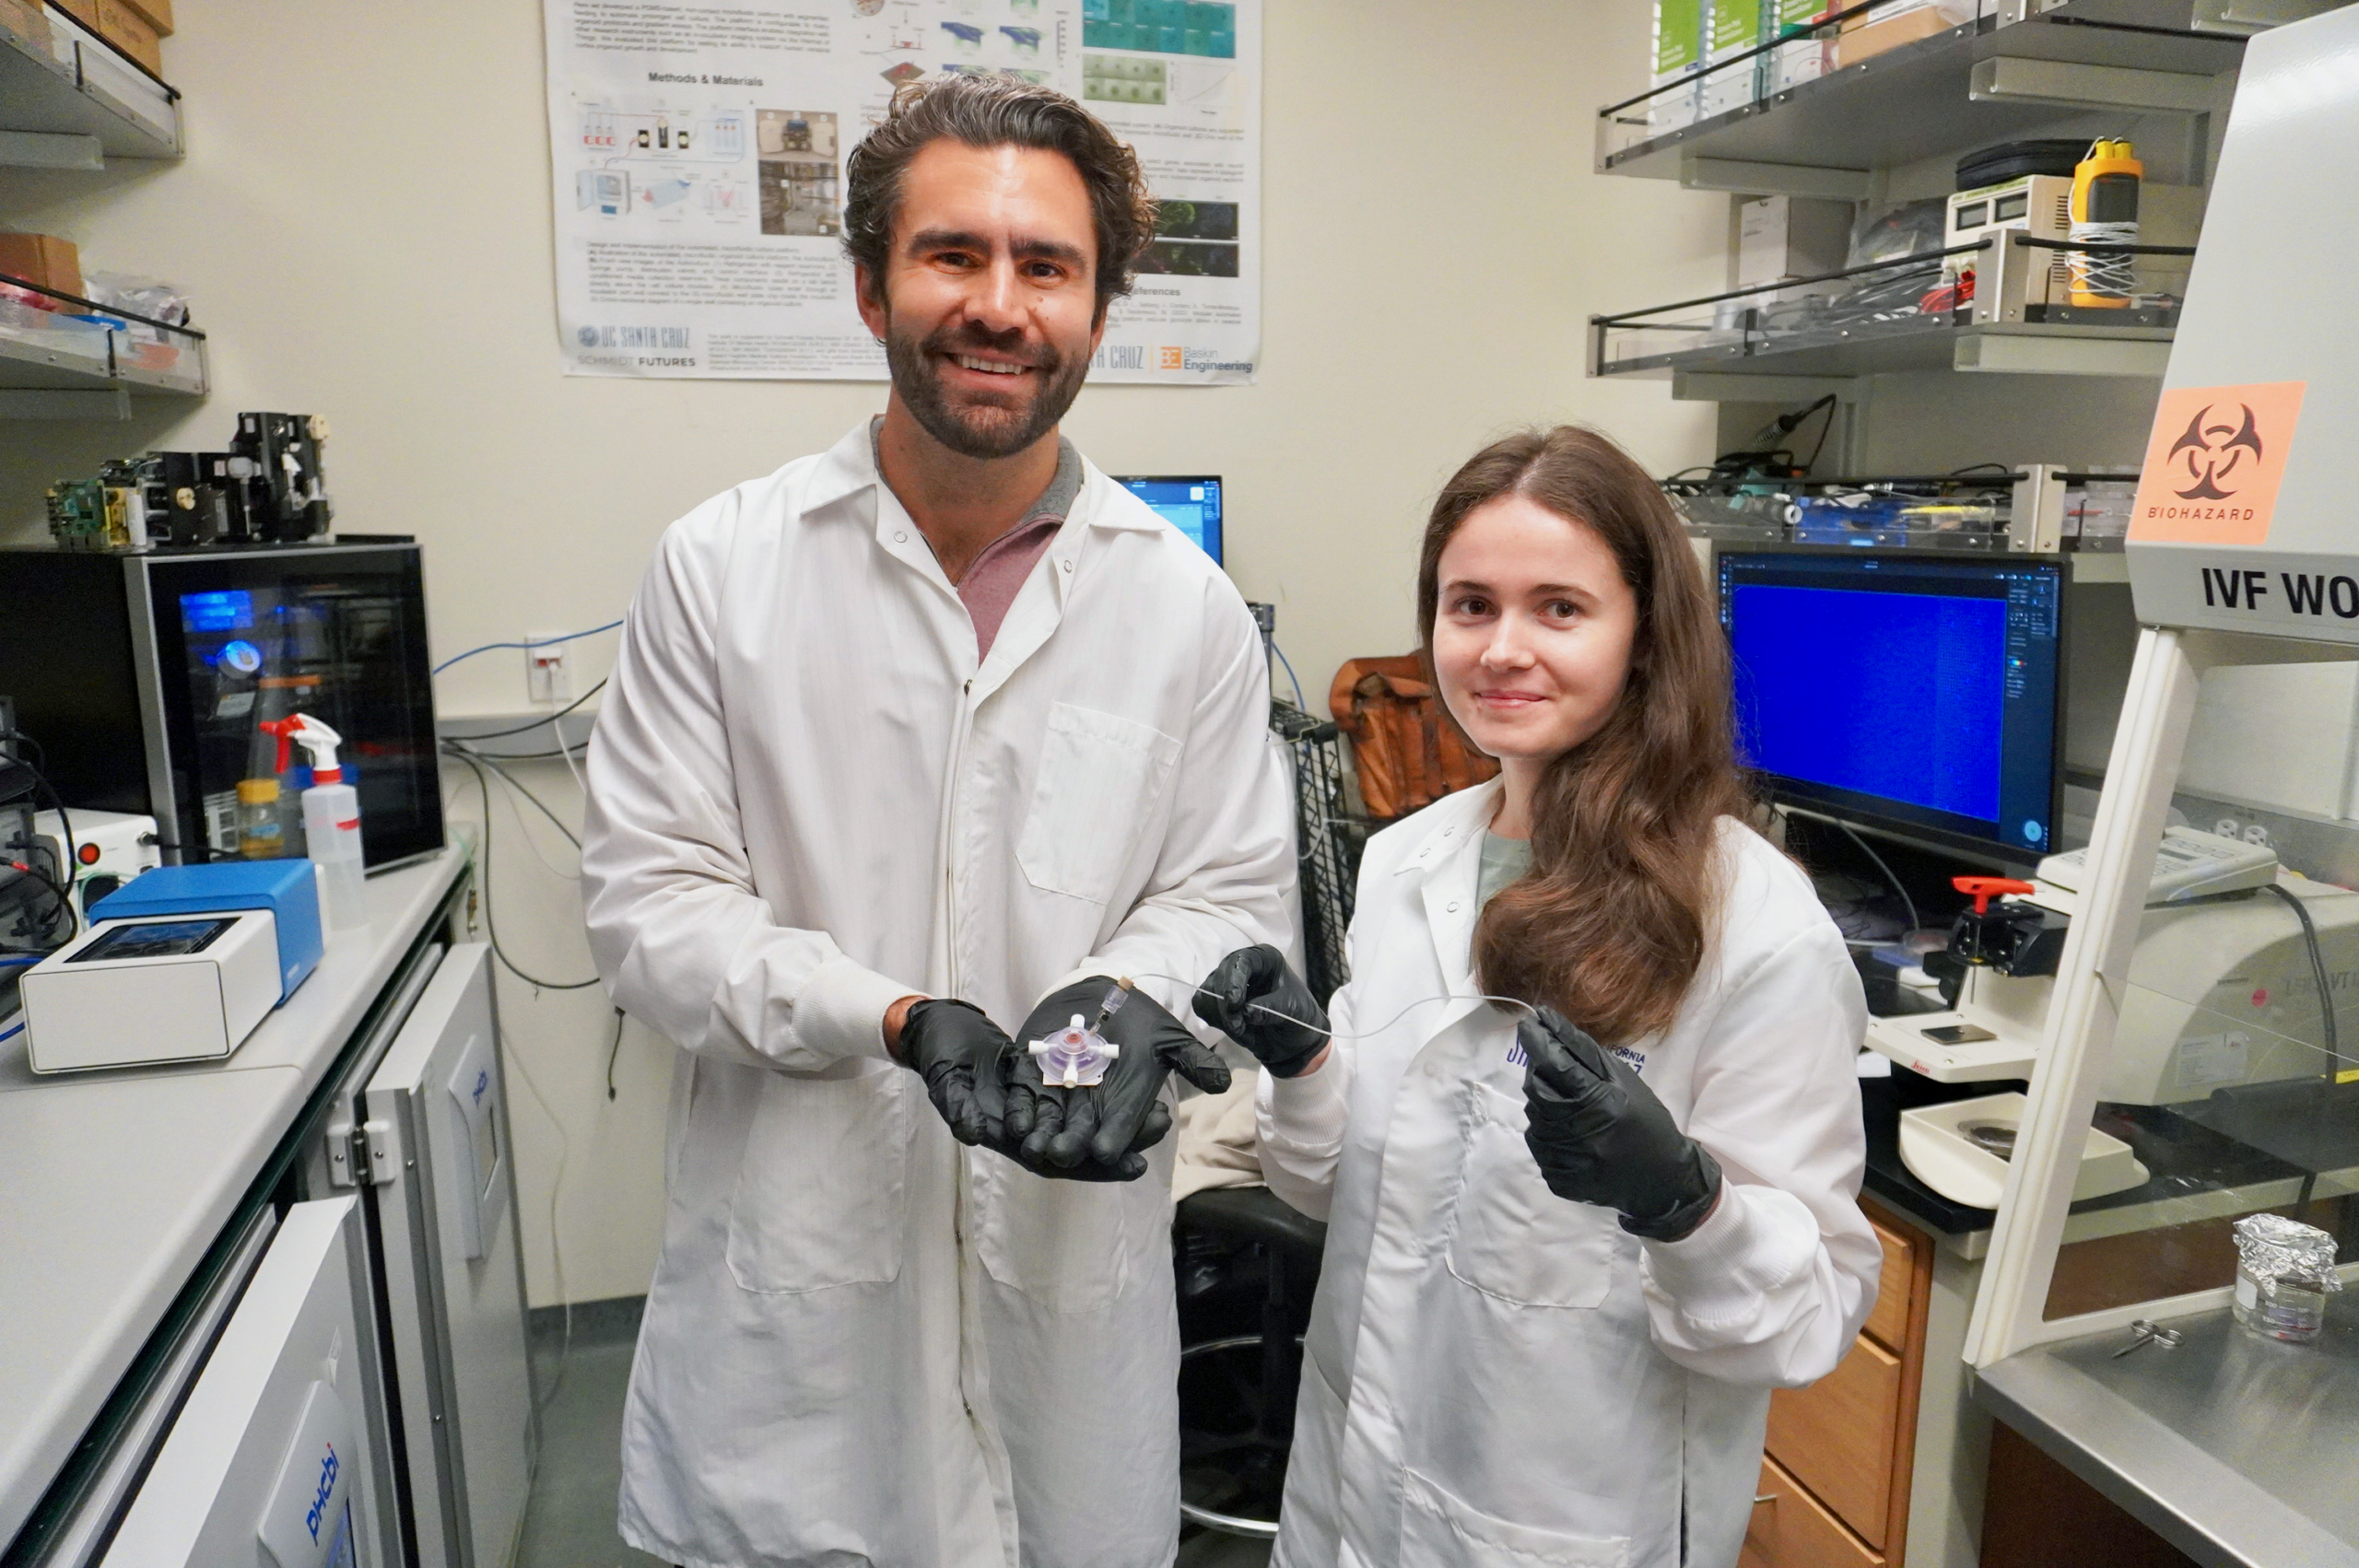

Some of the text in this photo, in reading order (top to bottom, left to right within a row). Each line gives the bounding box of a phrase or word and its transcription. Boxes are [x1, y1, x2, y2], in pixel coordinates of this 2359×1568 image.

[648, 72, 764, 87] Methods & Materials
[1133, 287, 1181, 297] eferences
[601, 325, 691, 349] UC SANTA CRUZ
[1109, 345, 1144, 369] CRUZ
[1183, 346, 1219, 359] Baskin
[577, 354, 697, 368] SCHMIDT FUTURES
[1183, 359, 1253, 374] Engineering
[2147, 506, 2255, 521] BIOHAZARD
[2201, 568, 2359, 619] IVF WO
[1910, 1059, 1931, 1075] Leica
[306, 1441, 340, 1548] PHCbi
